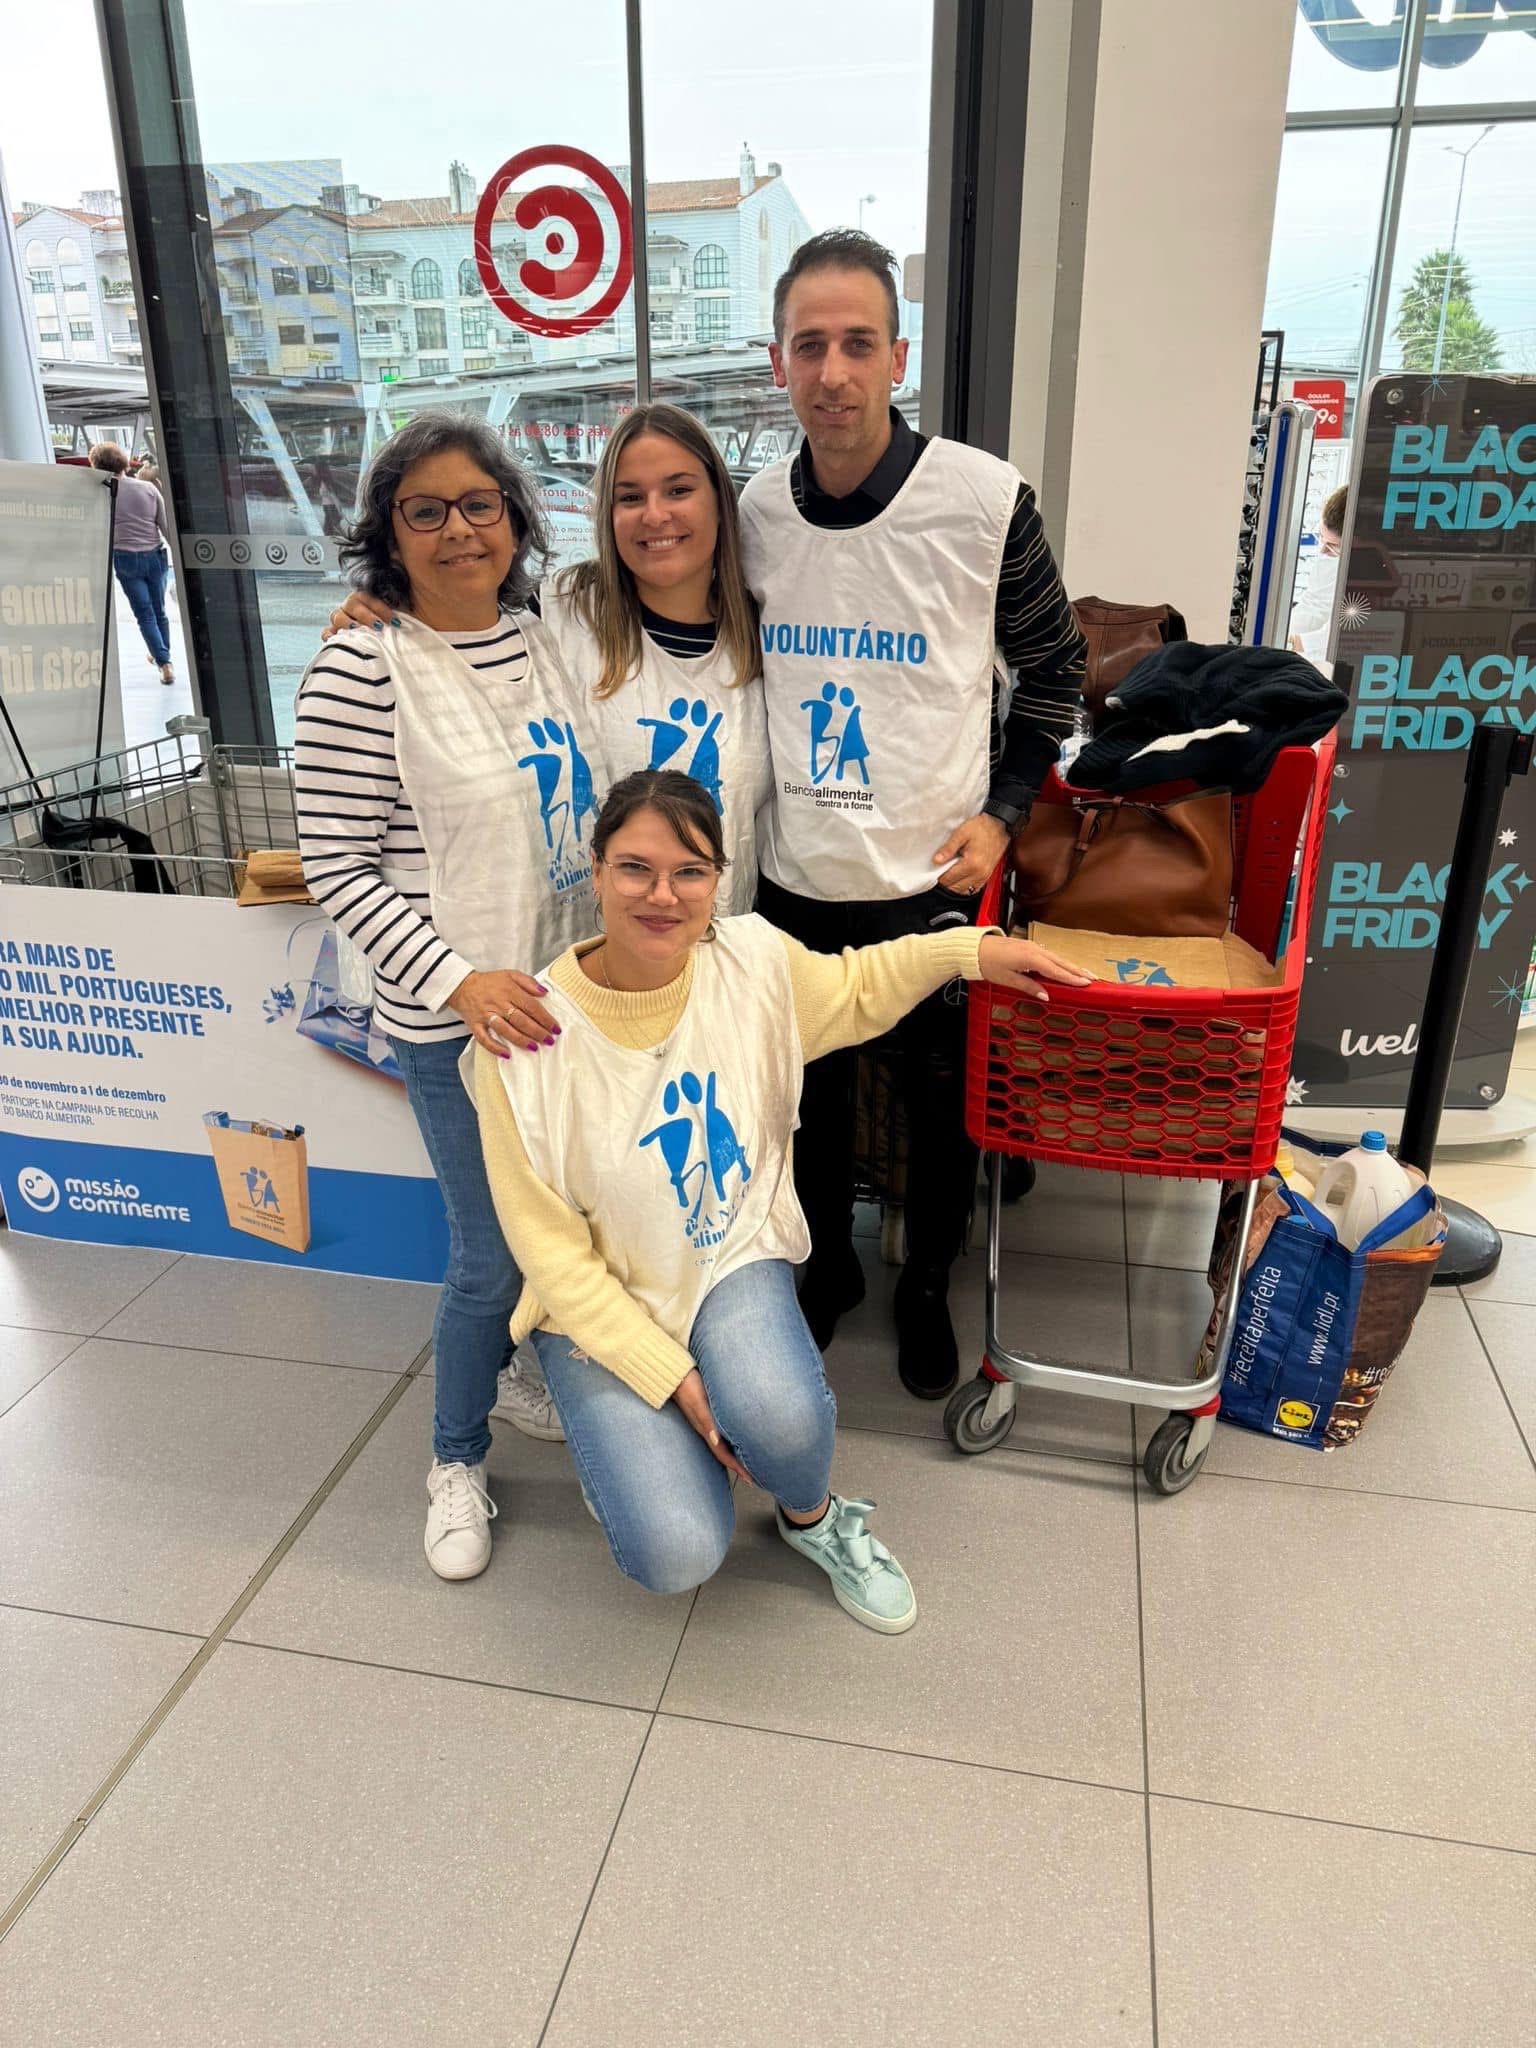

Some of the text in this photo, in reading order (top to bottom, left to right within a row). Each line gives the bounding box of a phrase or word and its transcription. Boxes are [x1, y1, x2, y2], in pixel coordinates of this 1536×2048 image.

[761, 621, 928, 664] VOLUNTÁRIO
[816, 799, 841, 809] contra
[851, 801, 874, 811] fome
[1322, 908, 1511, 948] FRIDY
[24, 942, 81, 969] MAIS
[85, 947, 115, 972] DE
[16, 970, 57, 995] MIL
[59, 974, 232, 1013] PORTUGUESES,
[0, 997, 205, 1036] MELHOR PRESENTE
[2, 1024, 144, 1059] A SUA AJUDA.
[11, 1076, 23, 1089] de
[24, 1079, 78, 1095] novembro
[88, 1085, 94, 1096] 1
[95, 1086, 109, 1098] de
[111, 1087, 166, 1103] dezembro
[1, 1093, 159, 1121] PARTICIPE NA CAMPANHA DE RECOLHA
[4, 1105, 95, 1126] DO BANCO ALIMENTAR.
[65, 1178, 140, 1199] MISSÃO
[69, 1196, 191, 1222] CONTINENTE
[1229, 1265, 1282, 1386] #receitaperfeita
[1307, 1291, 1340, 1365] www.lidl.pt
